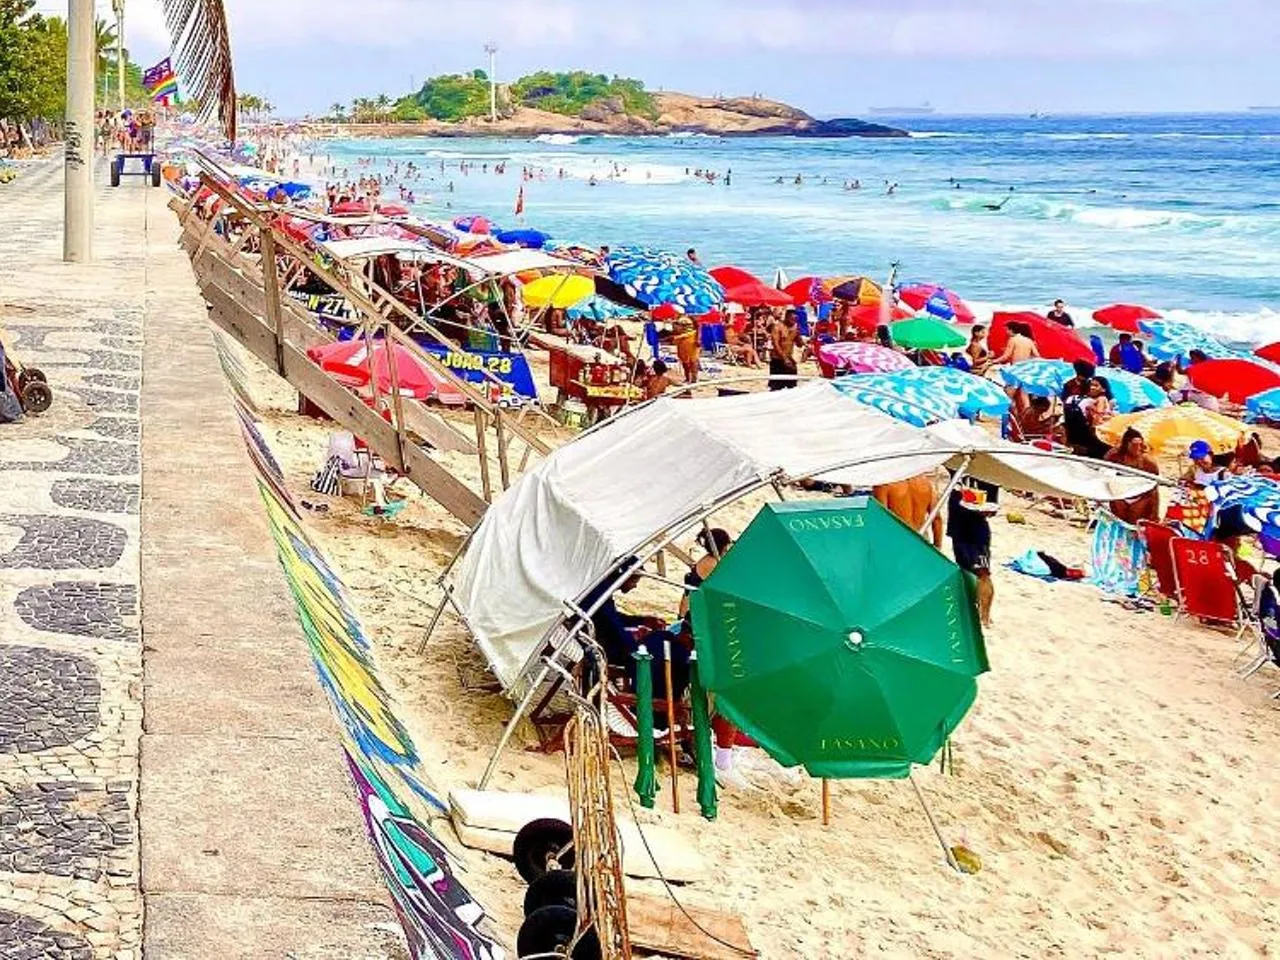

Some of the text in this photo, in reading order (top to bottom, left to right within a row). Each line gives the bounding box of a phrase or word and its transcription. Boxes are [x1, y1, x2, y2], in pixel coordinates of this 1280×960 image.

[487, 357, 512, 374] 28
[789, 514, 864, 532] FASANO
[1185, 549, 1209, 565] 28
[819, 738, 899, 750] FASANO
